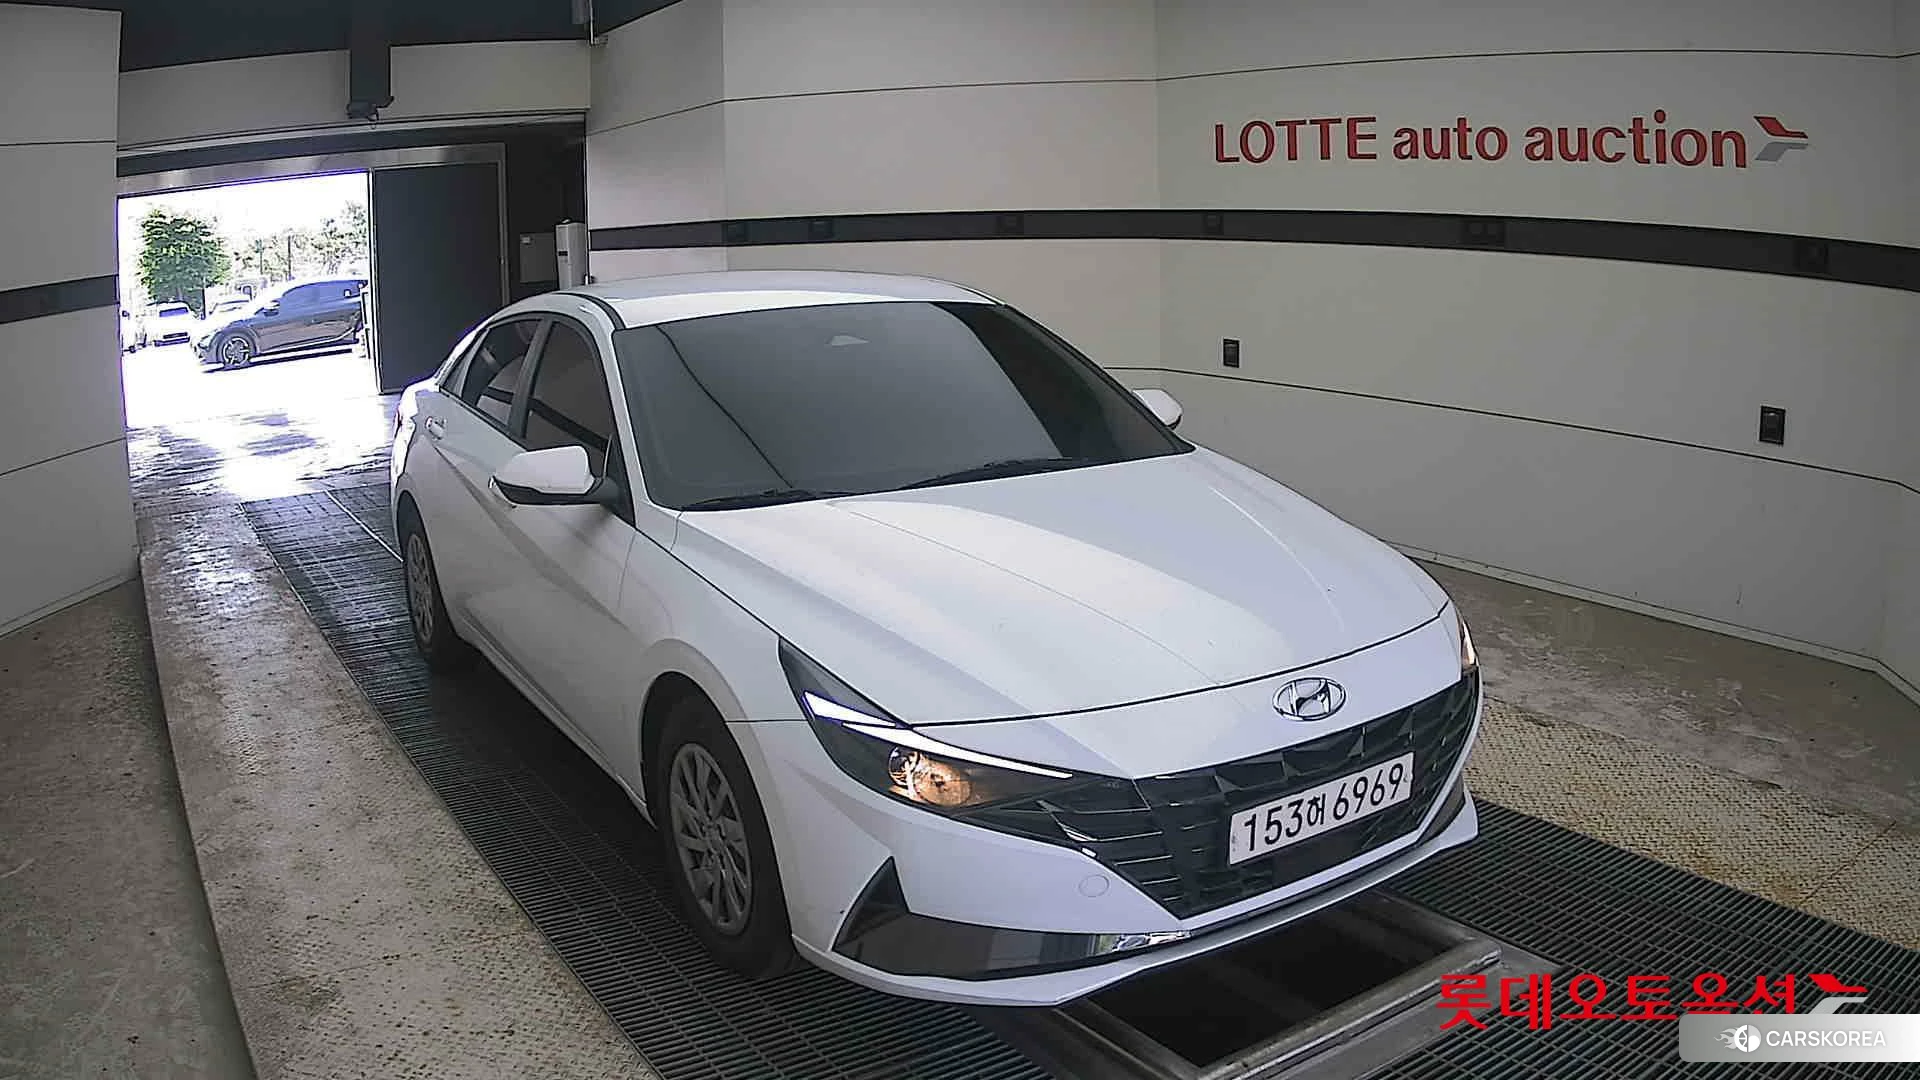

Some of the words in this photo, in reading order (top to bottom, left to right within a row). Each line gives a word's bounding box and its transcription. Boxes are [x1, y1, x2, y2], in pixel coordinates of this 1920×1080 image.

[1214, 115, 1378, 163] LOTTE
[1393, 116, 1509, 161] auto
[1524, 109, 1747, 169] auction
